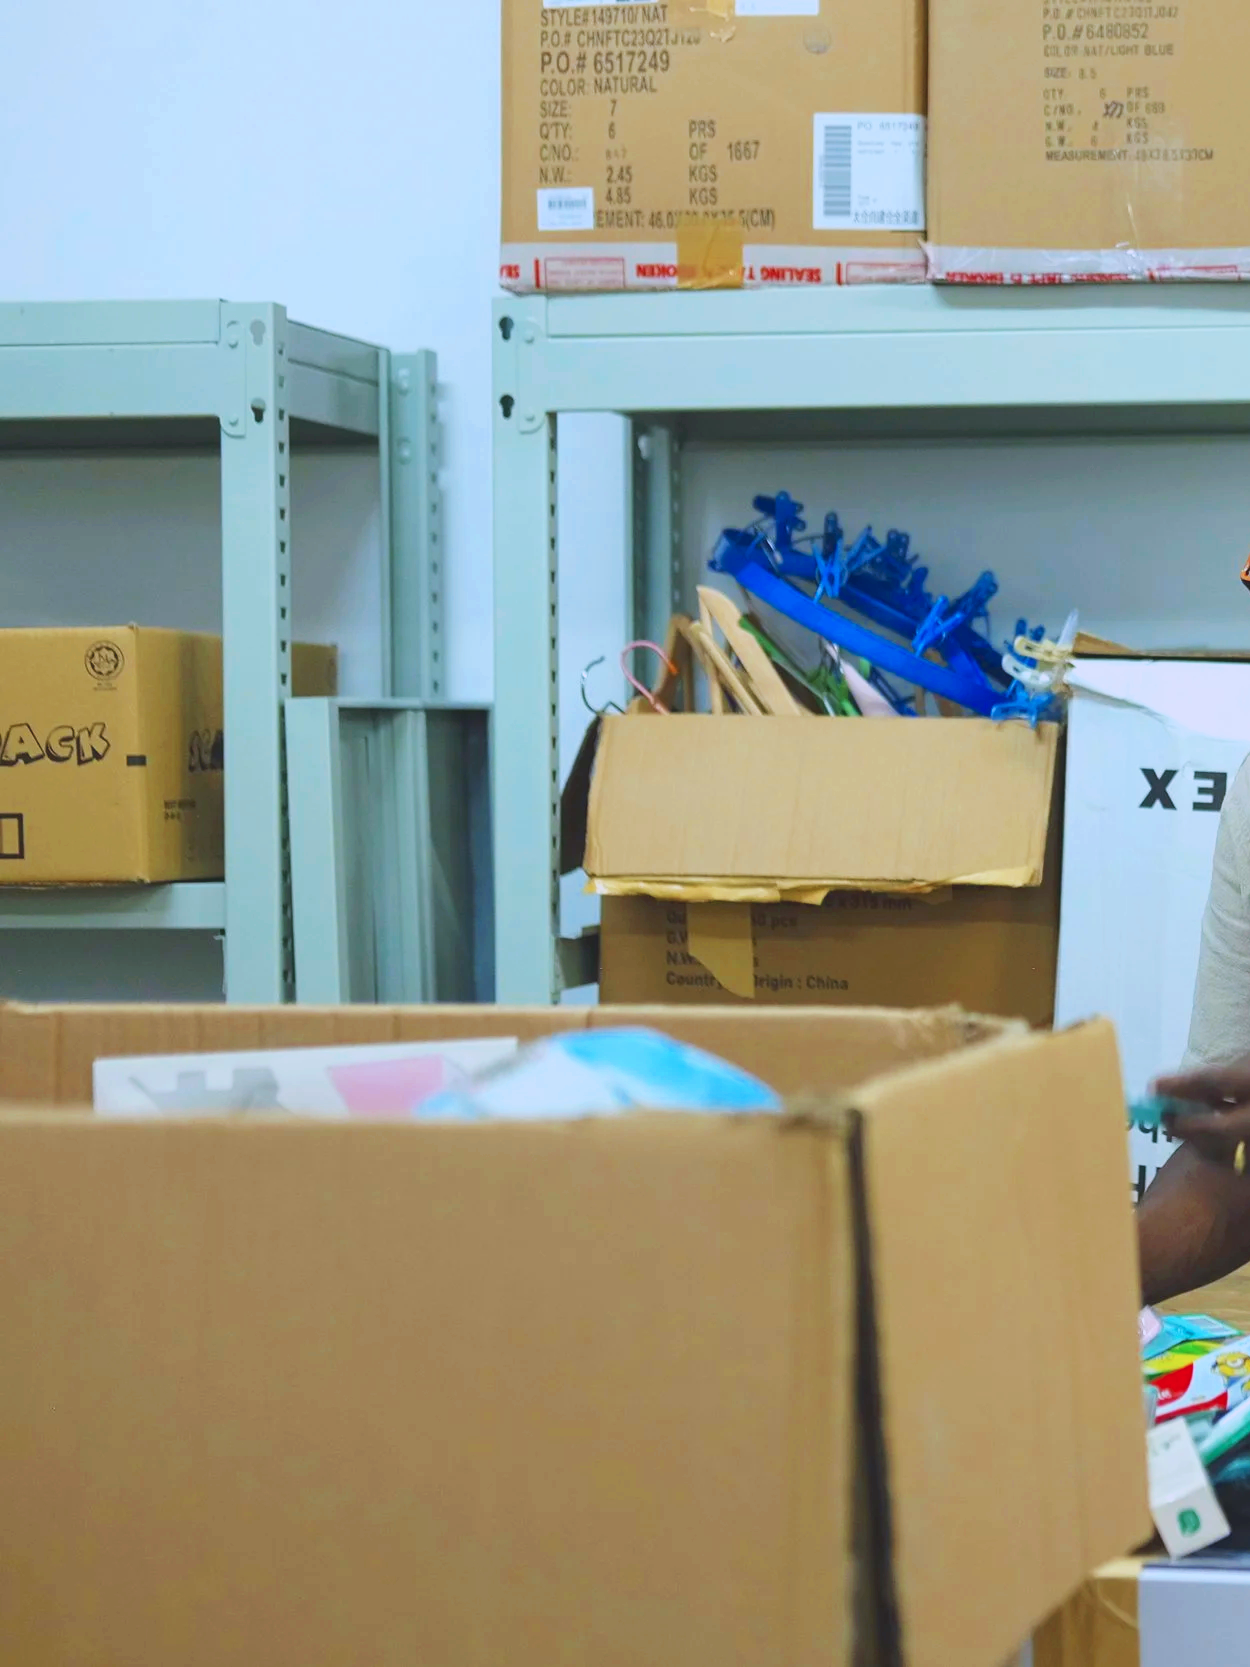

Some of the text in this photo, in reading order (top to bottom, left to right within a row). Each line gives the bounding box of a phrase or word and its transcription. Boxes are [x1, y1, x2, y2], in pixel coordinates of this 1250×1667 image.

[541, 50, 671, 74] P.O.# 6517249
[593, 75, 658, 94] NATURAL
[540, 99, 618, 118] SIZE: 7
[608, 121, 616, 140] 6
[689, 118, 717, 139] PRS
[689, 142, 707, 162] OF
[726, 140, 760, 162] 1667
[606, 165, 632, 184] 2.45
[689, 164, 718, 183] KGS
[605, 186, 718, 206] 4.85 KGS
[594, 209, 646, 230] EMENT:
[761, 267, 822, 283] SEALING
[0, 722, 111, 767] ACK
[752, 973, 794, 992] rigin
[806, 972, 849, 991] China
